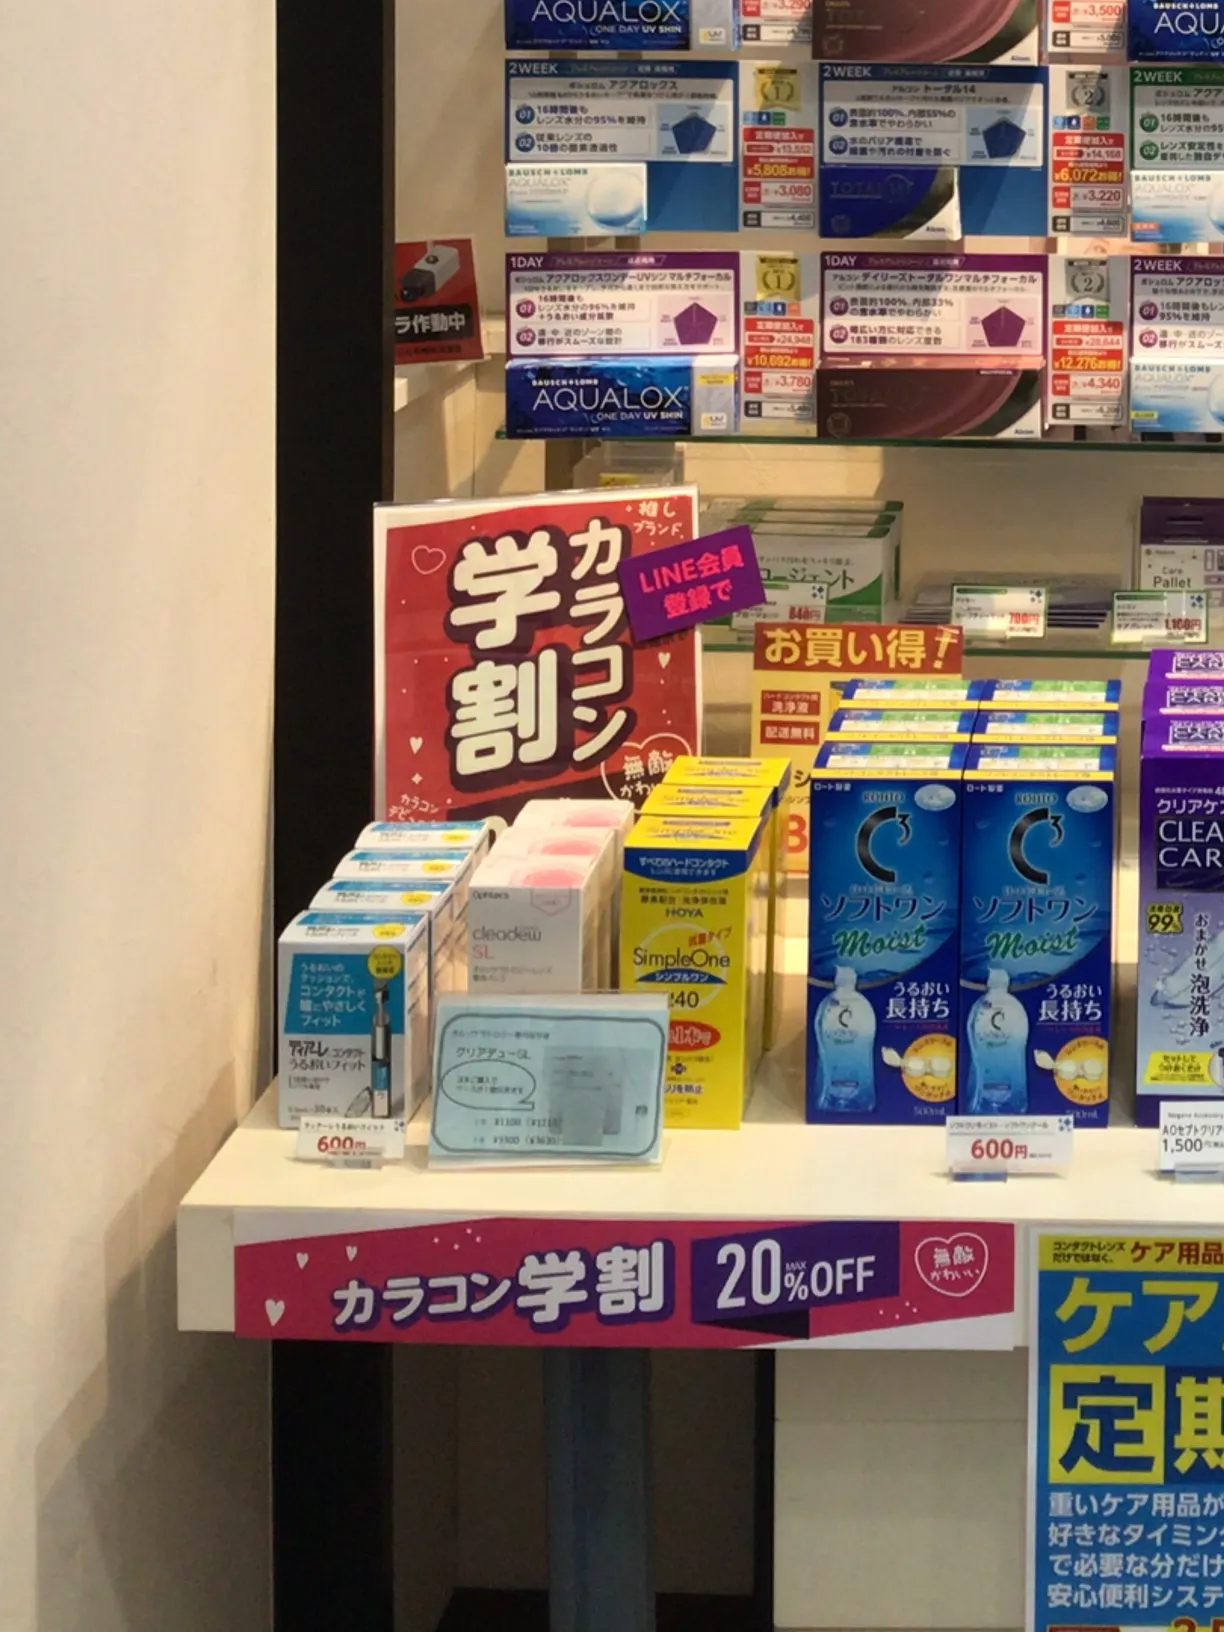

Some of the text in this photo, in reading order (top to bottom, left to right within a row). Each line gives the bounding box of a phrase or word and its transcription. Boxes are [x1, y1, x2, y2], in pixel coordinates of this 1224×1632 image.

[532, 0, 680, 22] AQUALOX
[596, 25, 681, 34] ONE DAY UV SHIN
[509, 62, 558, 74] 2WEEK
[823, 66, 872, 77] 2WEEK
[1134, 70, 1182, 82] 2WEEK
[511, 257, 544, 268] 1DAY
[824, 256, 857, 266] 1DAY
[1134, 259, 1182, 271] 2WEEK
[533, 387, 682, 410] AQUALOX
[620, 412, 640, 420] DAY
[639, 545, 744, 593] LINE会員
[1153, 575, 1192, 588] Pallet
[663, 581, 732, 619] 登録で
[569, 519, 627, 762] カラコン
[450, 531, 561, 776] 学割
[666, 908, 703, 918] HOYA
[822, 896, 946, 920] ソフトワン
[974, 896, 1097, 924] ソフトワン
[473, 926, 541, 942] cleadew
[834, 925, 925, 956] Moist
[987, 927, 1079, 960] Moist
[473, 947, 494, 960] SL
[633, 948, 730, 968] SimpleOne
[656, 973, 708, 981] シンプルワン
[893, 982, 950, 996] うるおい
[1046, 985, 1102, 998] うるおい
[885, 998, 949, 1020] 長持ち
[1039, 1001, 1102, 1021] 長持ち
[302, 1016, 340, 1026] フィット
[1052, 1242, 1125, 1253] コンタクトレンズ
